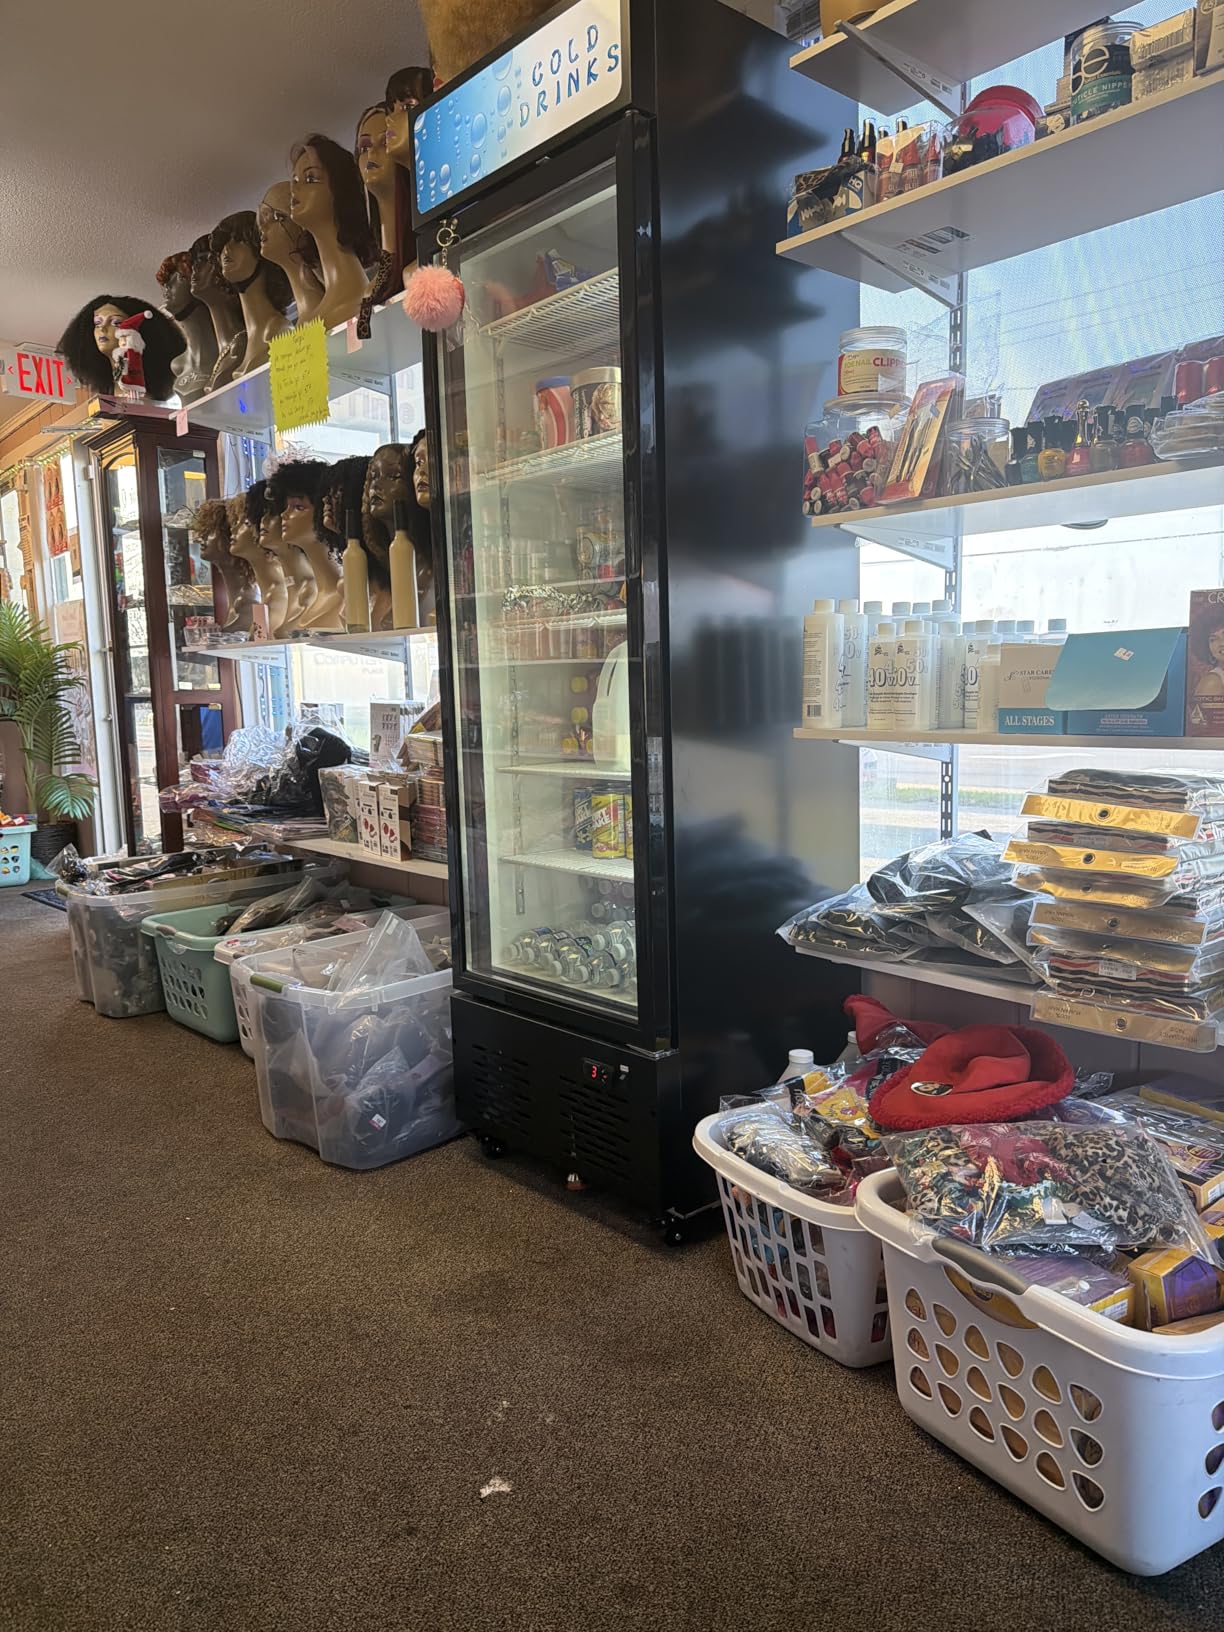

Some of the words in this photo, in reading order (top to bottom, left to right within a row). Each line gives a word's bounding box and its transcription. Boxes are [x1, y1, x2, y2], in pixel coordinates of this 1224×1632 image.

[532, 24, 600, 88] COLD
[519, 43, 621, 128] DRINKS
[16, 352, 65, 398] EXIT
[1004, 715, 1021, 727] ALL
[1022, 715, 1055, 727] STAGES
[591, 1066, 598, 1078] 3
